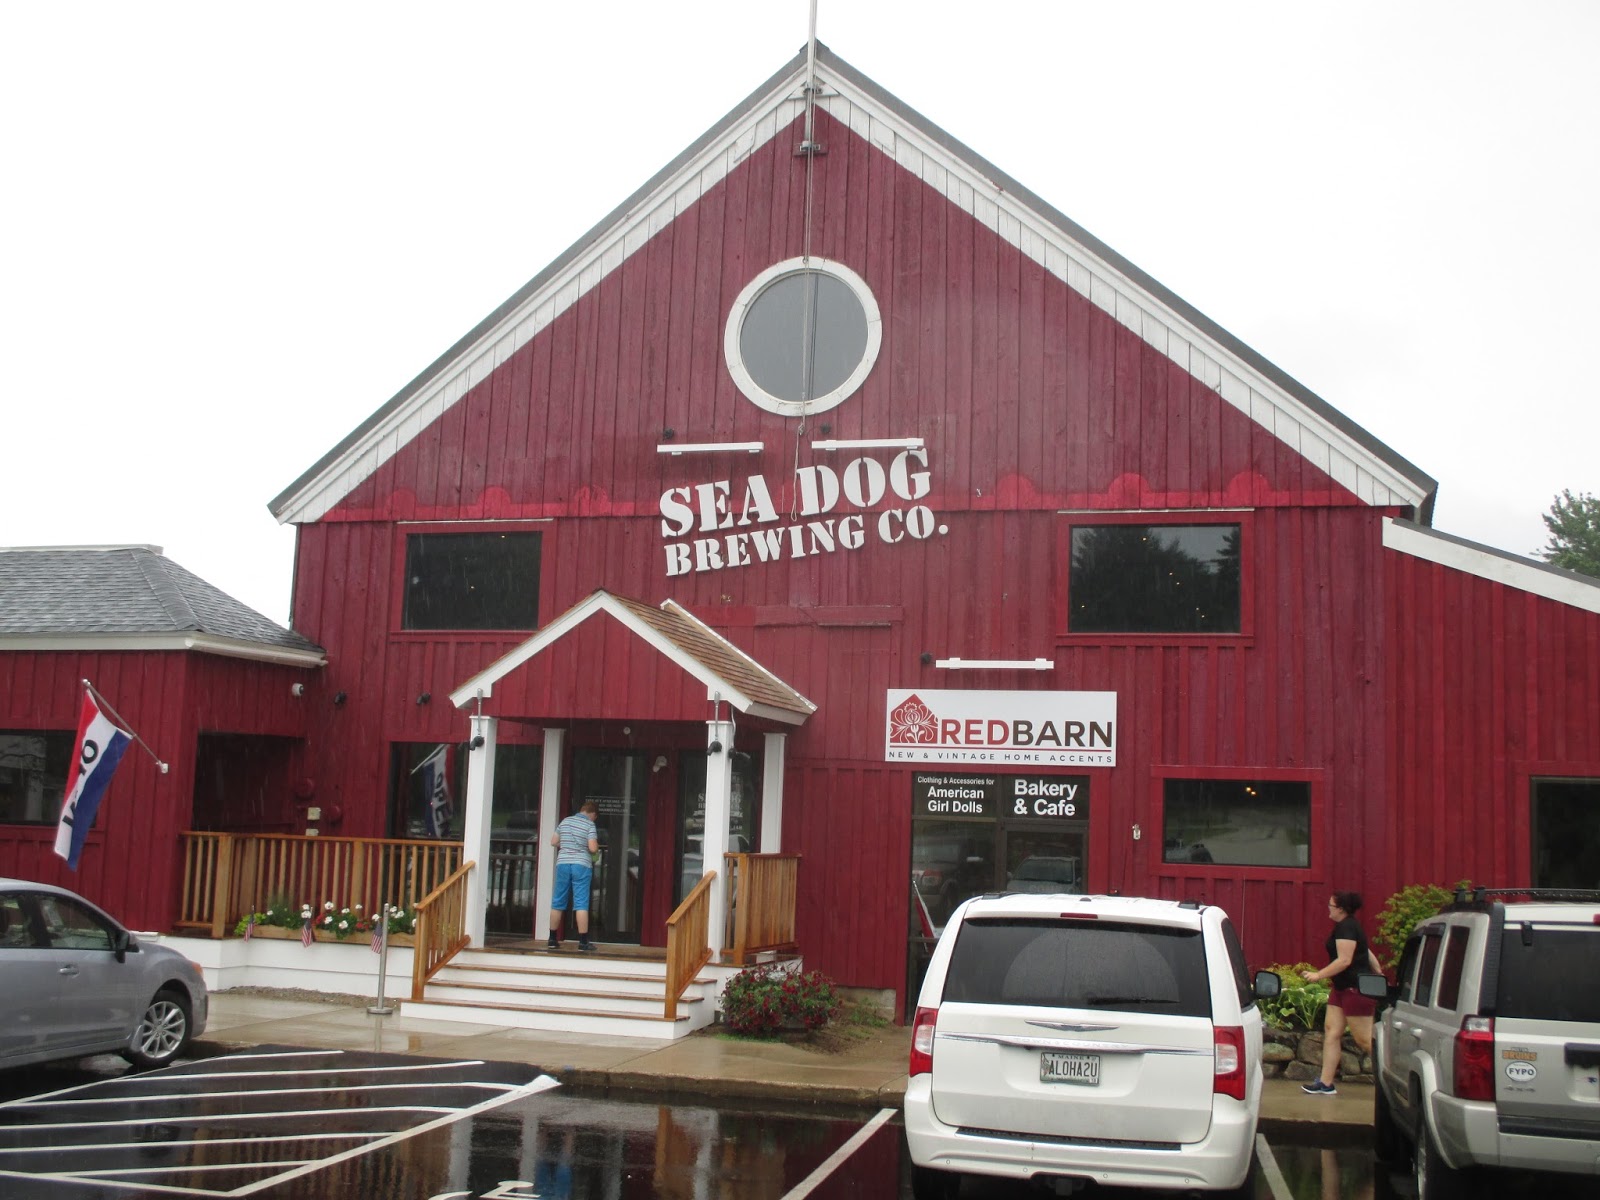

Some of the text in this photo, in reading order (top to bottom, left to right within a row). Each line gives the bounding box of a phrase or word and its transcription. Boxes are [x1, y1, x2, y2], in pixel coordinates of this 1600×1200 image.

[659, 447, 931, 538] SEA DOG
[664, 505, 949, 577] BREWING CO.
[889, 751, 914, 759] NEW
[938, 752, 995, 760] VINTAGE
[1004, 753, 1040, 761] HOME
[1049, 754, 1112, 763] ACCENTS
[917, 776, 942, 785] Clothing
[949, 777, 985, 785] Accessories
[927, 785, 985, 799] American
[1014, 779, 1079, 801] Bakery
[927, 800, 983, 814] Girl Dolls
[1013, 798, 1076, 816] & Cafe
[1048, 1060, 1098, 1078] ALOHA2U
[1508, 1067, 1535, 1076] FYPO
